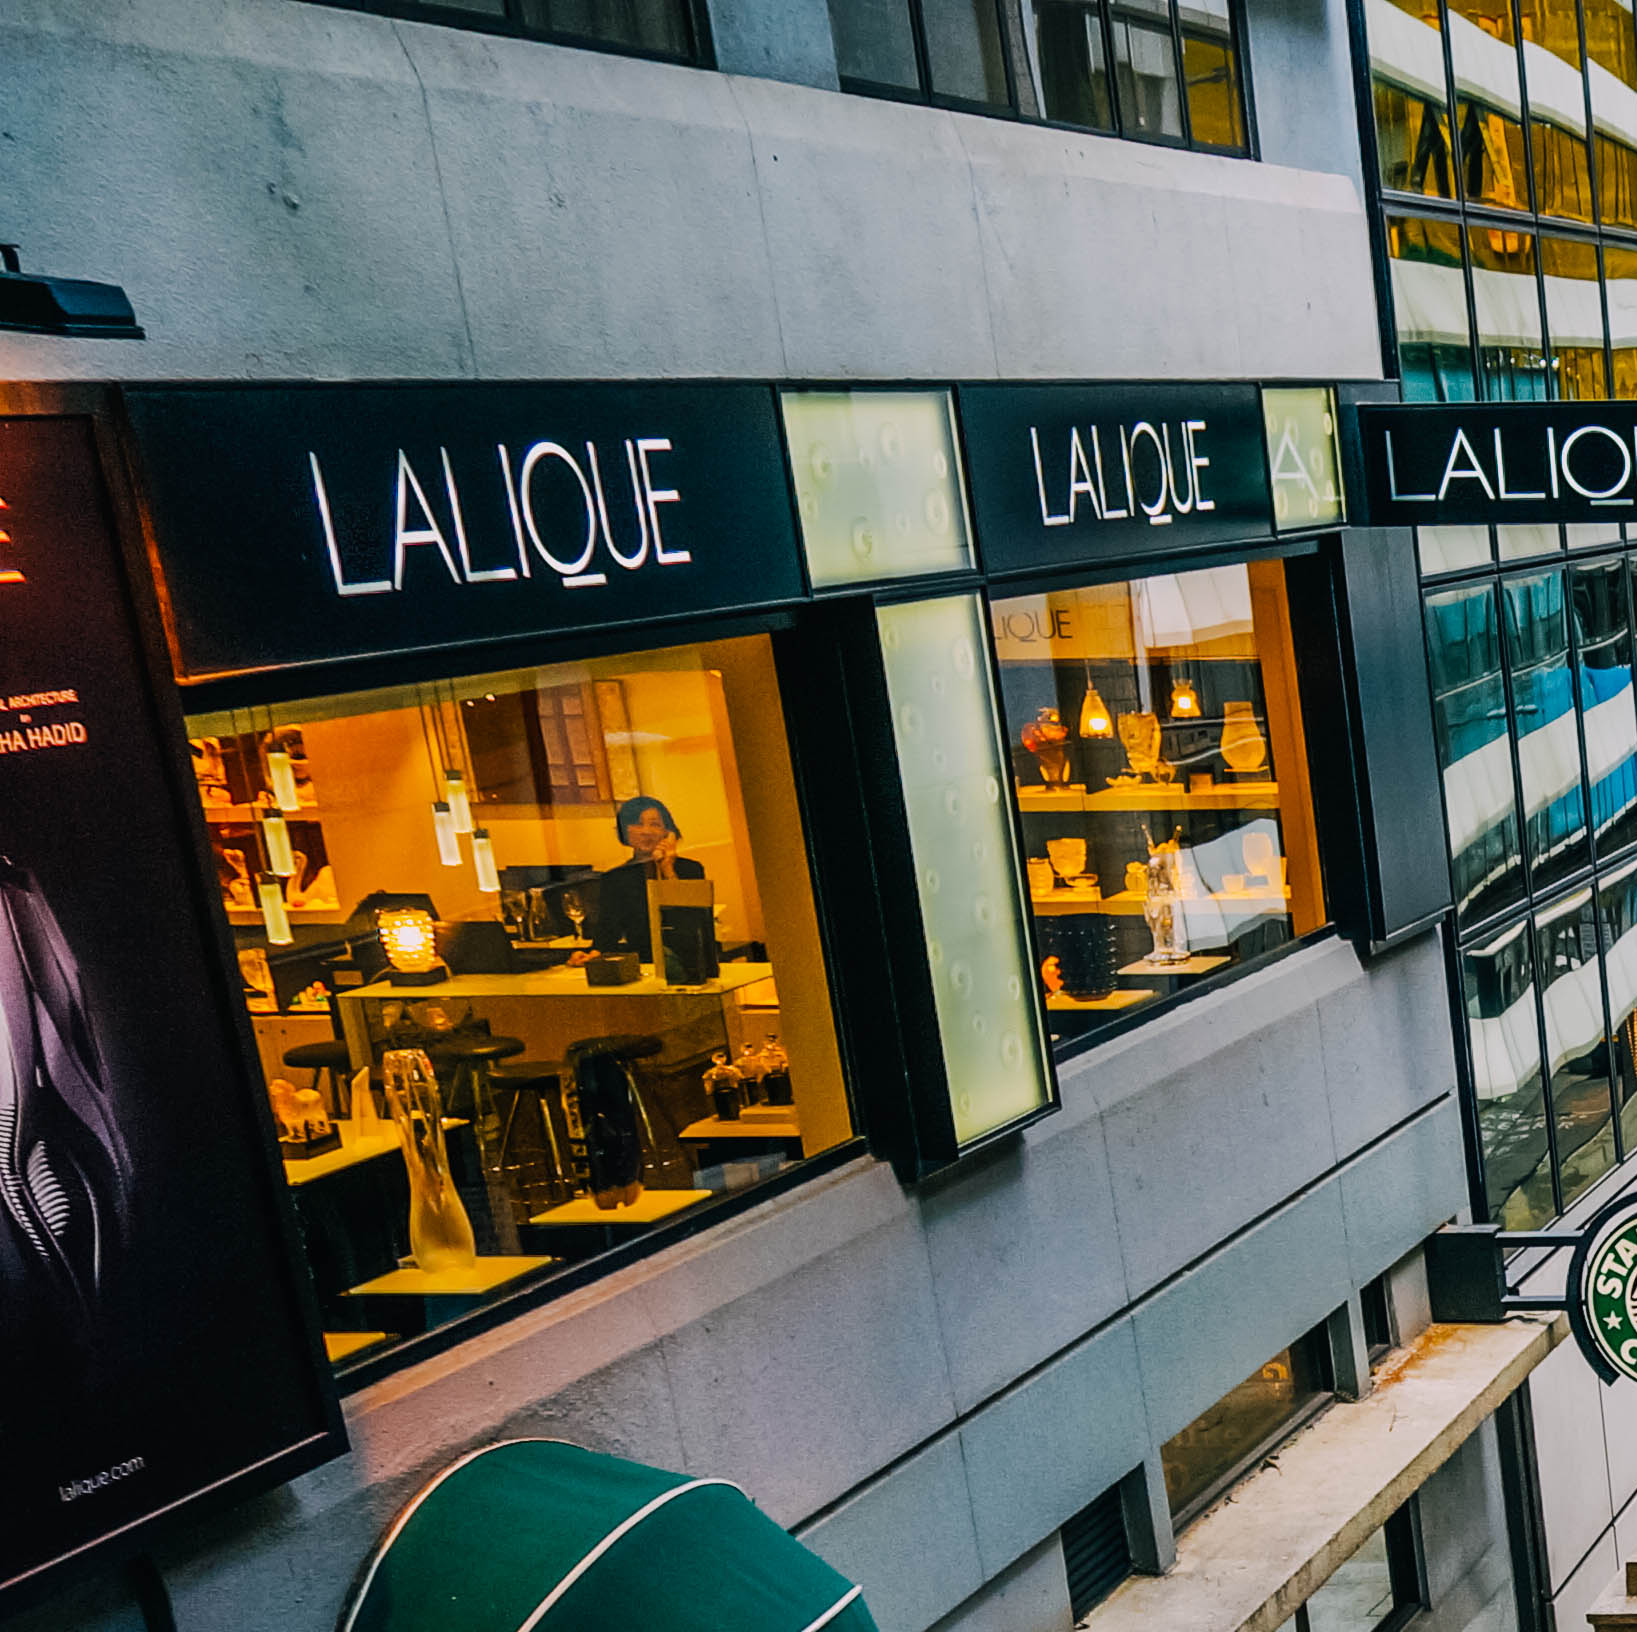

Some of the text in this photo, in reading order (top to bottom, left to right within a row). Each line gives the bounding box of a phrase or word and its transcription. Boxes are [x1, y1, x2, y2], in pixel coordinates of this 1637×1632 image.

[309, 438, 691, 596] LALIQUE
[1030, 419, 1215, 527] LALIQUE
[25, 721, 88, 750] HADID
